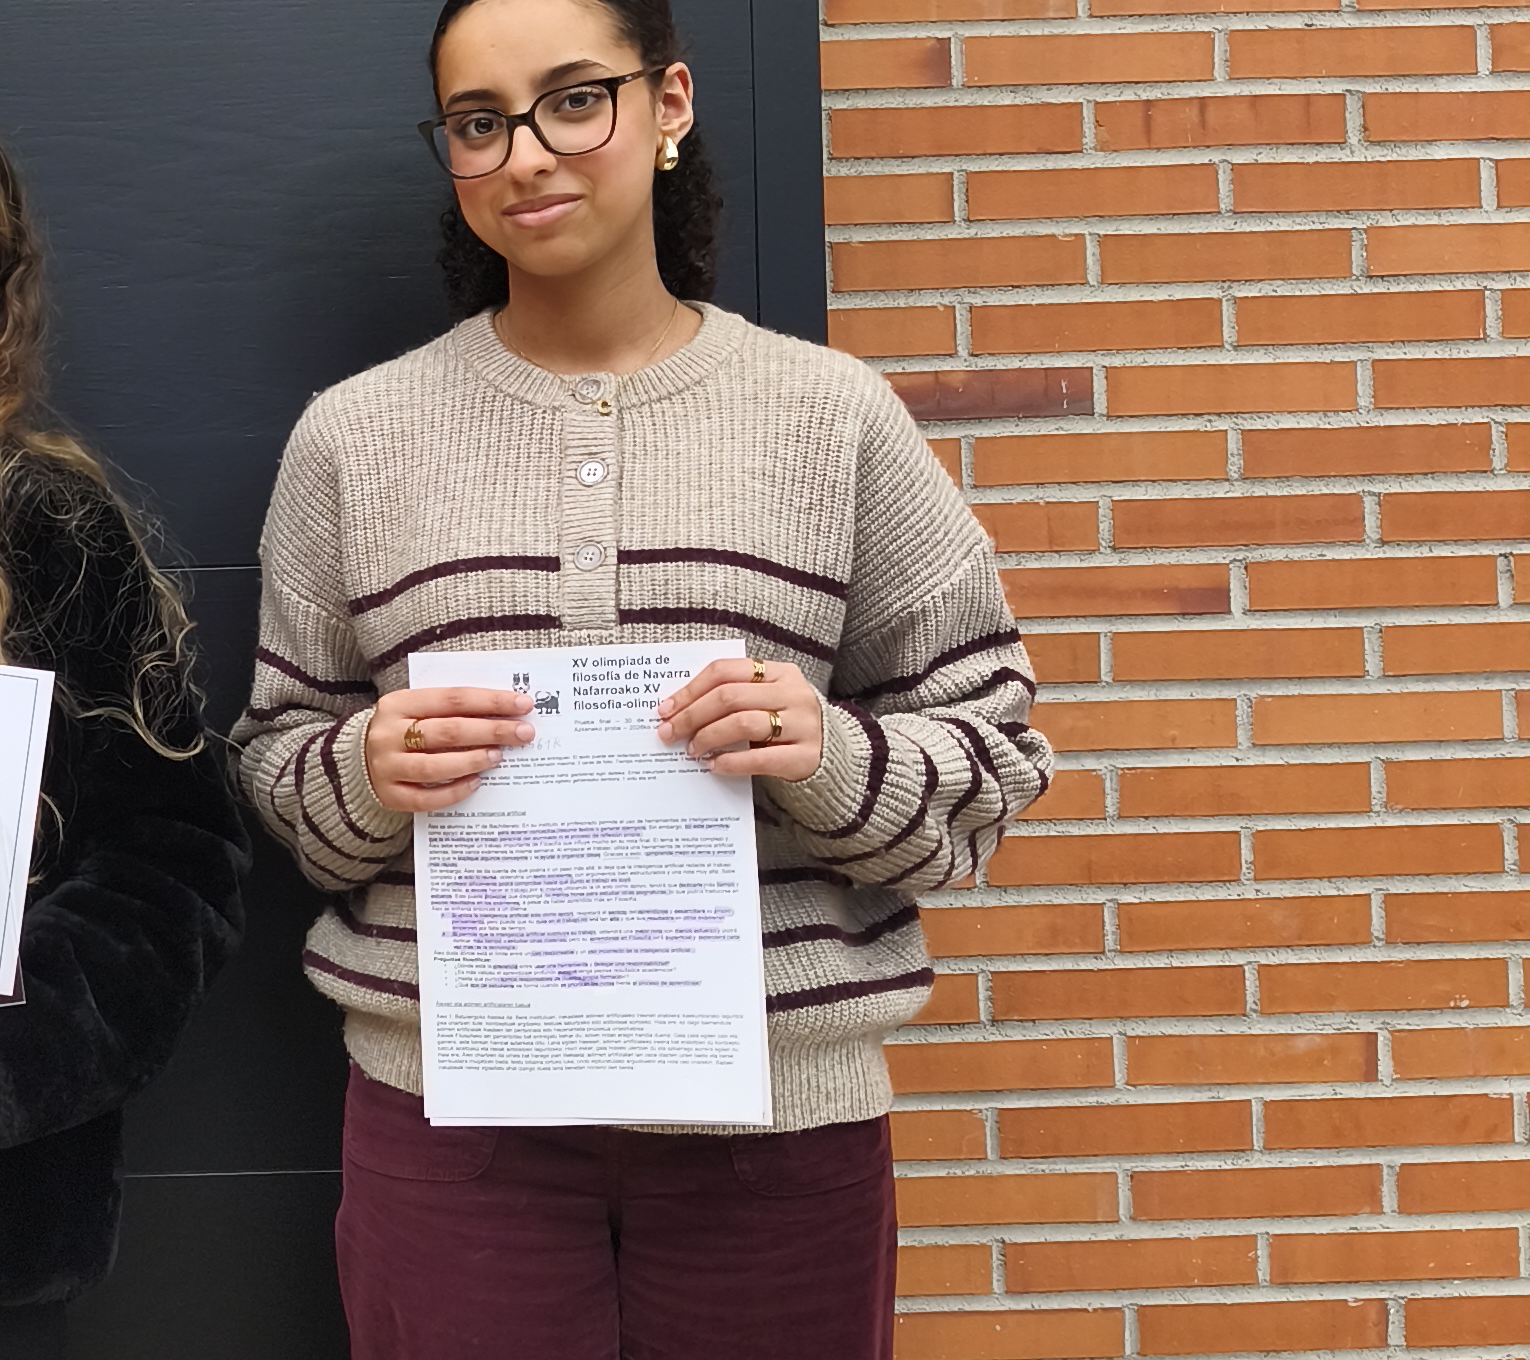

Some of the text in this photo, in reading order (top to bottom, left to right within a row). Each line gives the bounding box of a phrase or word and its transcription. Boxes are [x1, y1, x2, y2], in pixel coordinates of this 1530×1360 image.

[572, 655, 670, 668] XV olimpiada de
[572, 669, 691, 682] filosofía de Navarra
[573, 683, 661, 697] Nafarroako XV
[573, 697, 664, 710] filosofia-olinpi
